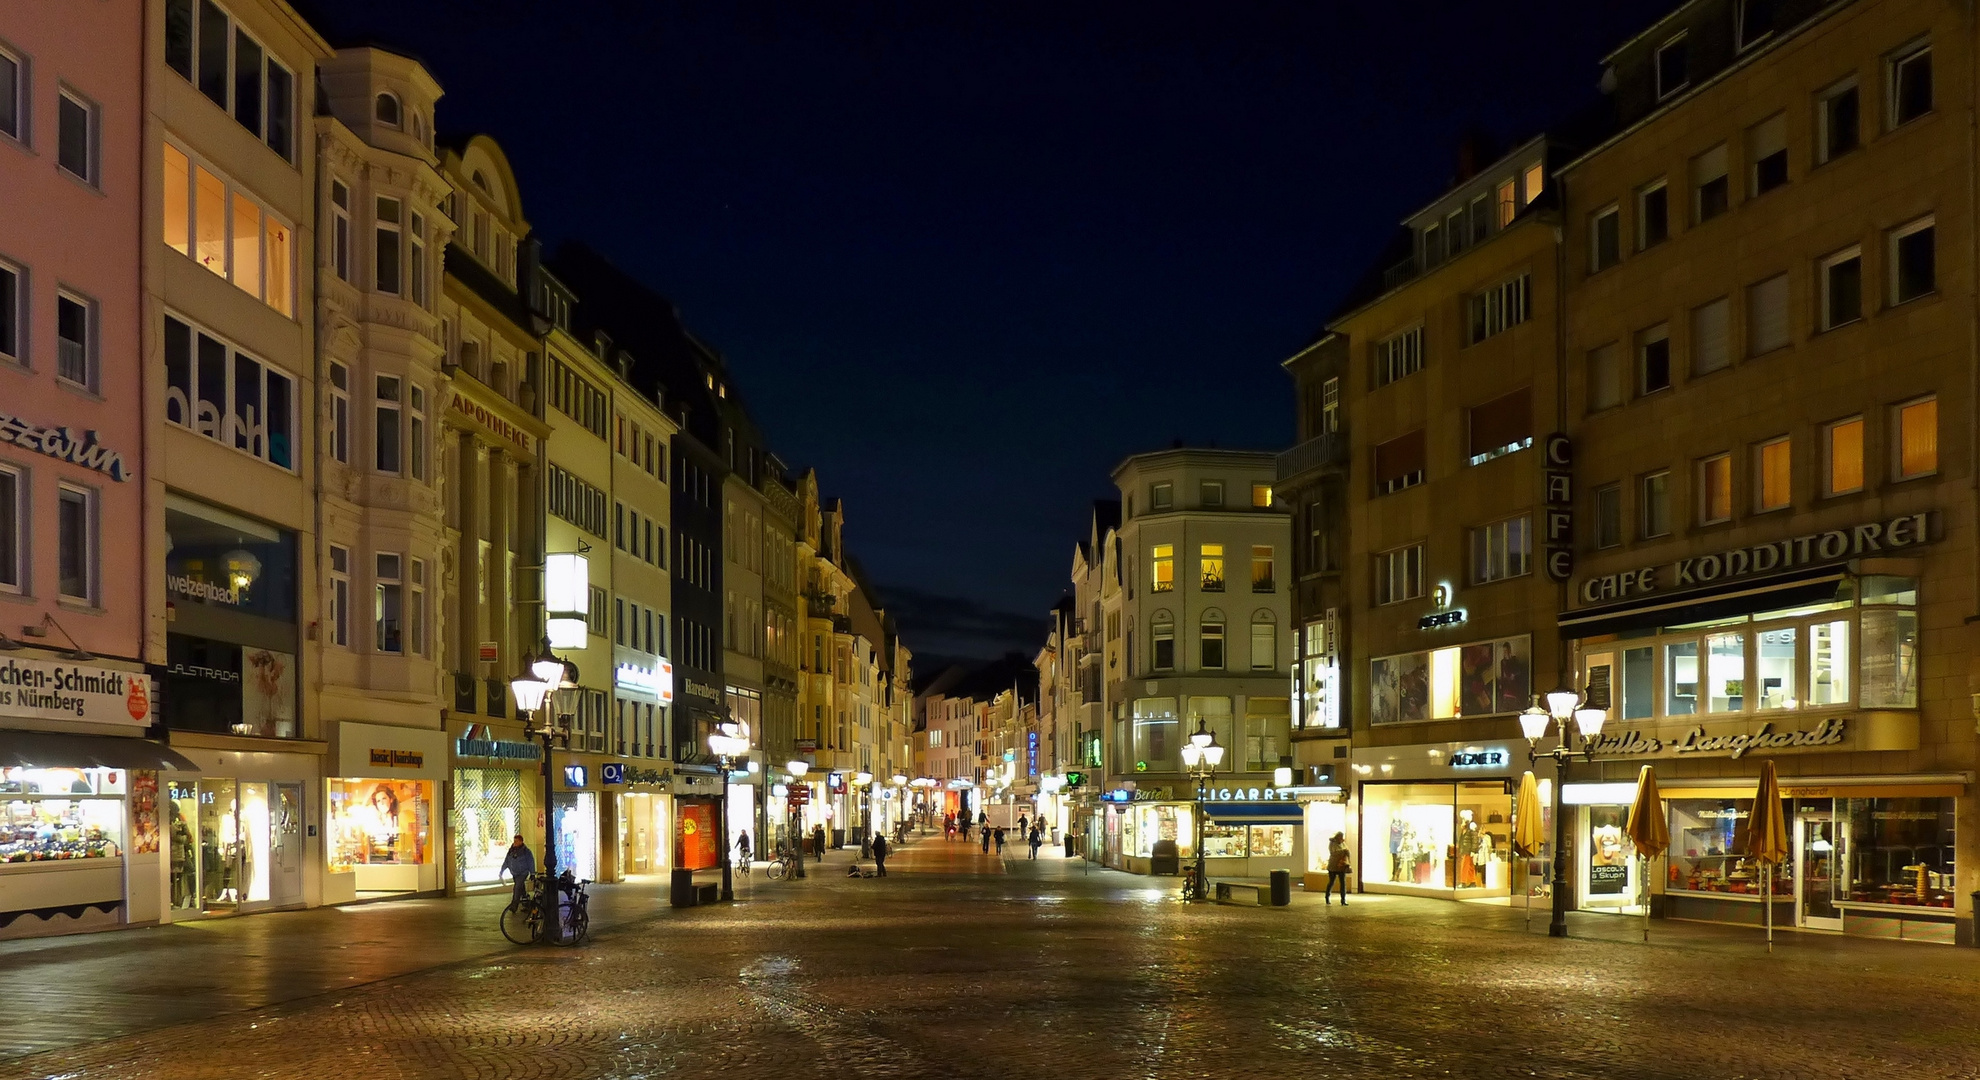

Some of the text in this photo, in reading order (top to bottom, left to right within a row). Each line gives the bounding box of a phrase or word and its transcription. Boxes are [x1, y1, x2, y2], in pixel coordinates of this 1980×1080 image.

[452, 393, 530, 451] APOTHEKE
[1549, 437, 1571, 578] CAFE
[1674, 513, 1927, 587] KONDITOREI
[17, 689, 85, 717] Nürnberg
[370, 749, 390, 764] basic
[1029, 732, 1037, 775] OPTIK
[1448, 752, 1503, 767] AIGNER
